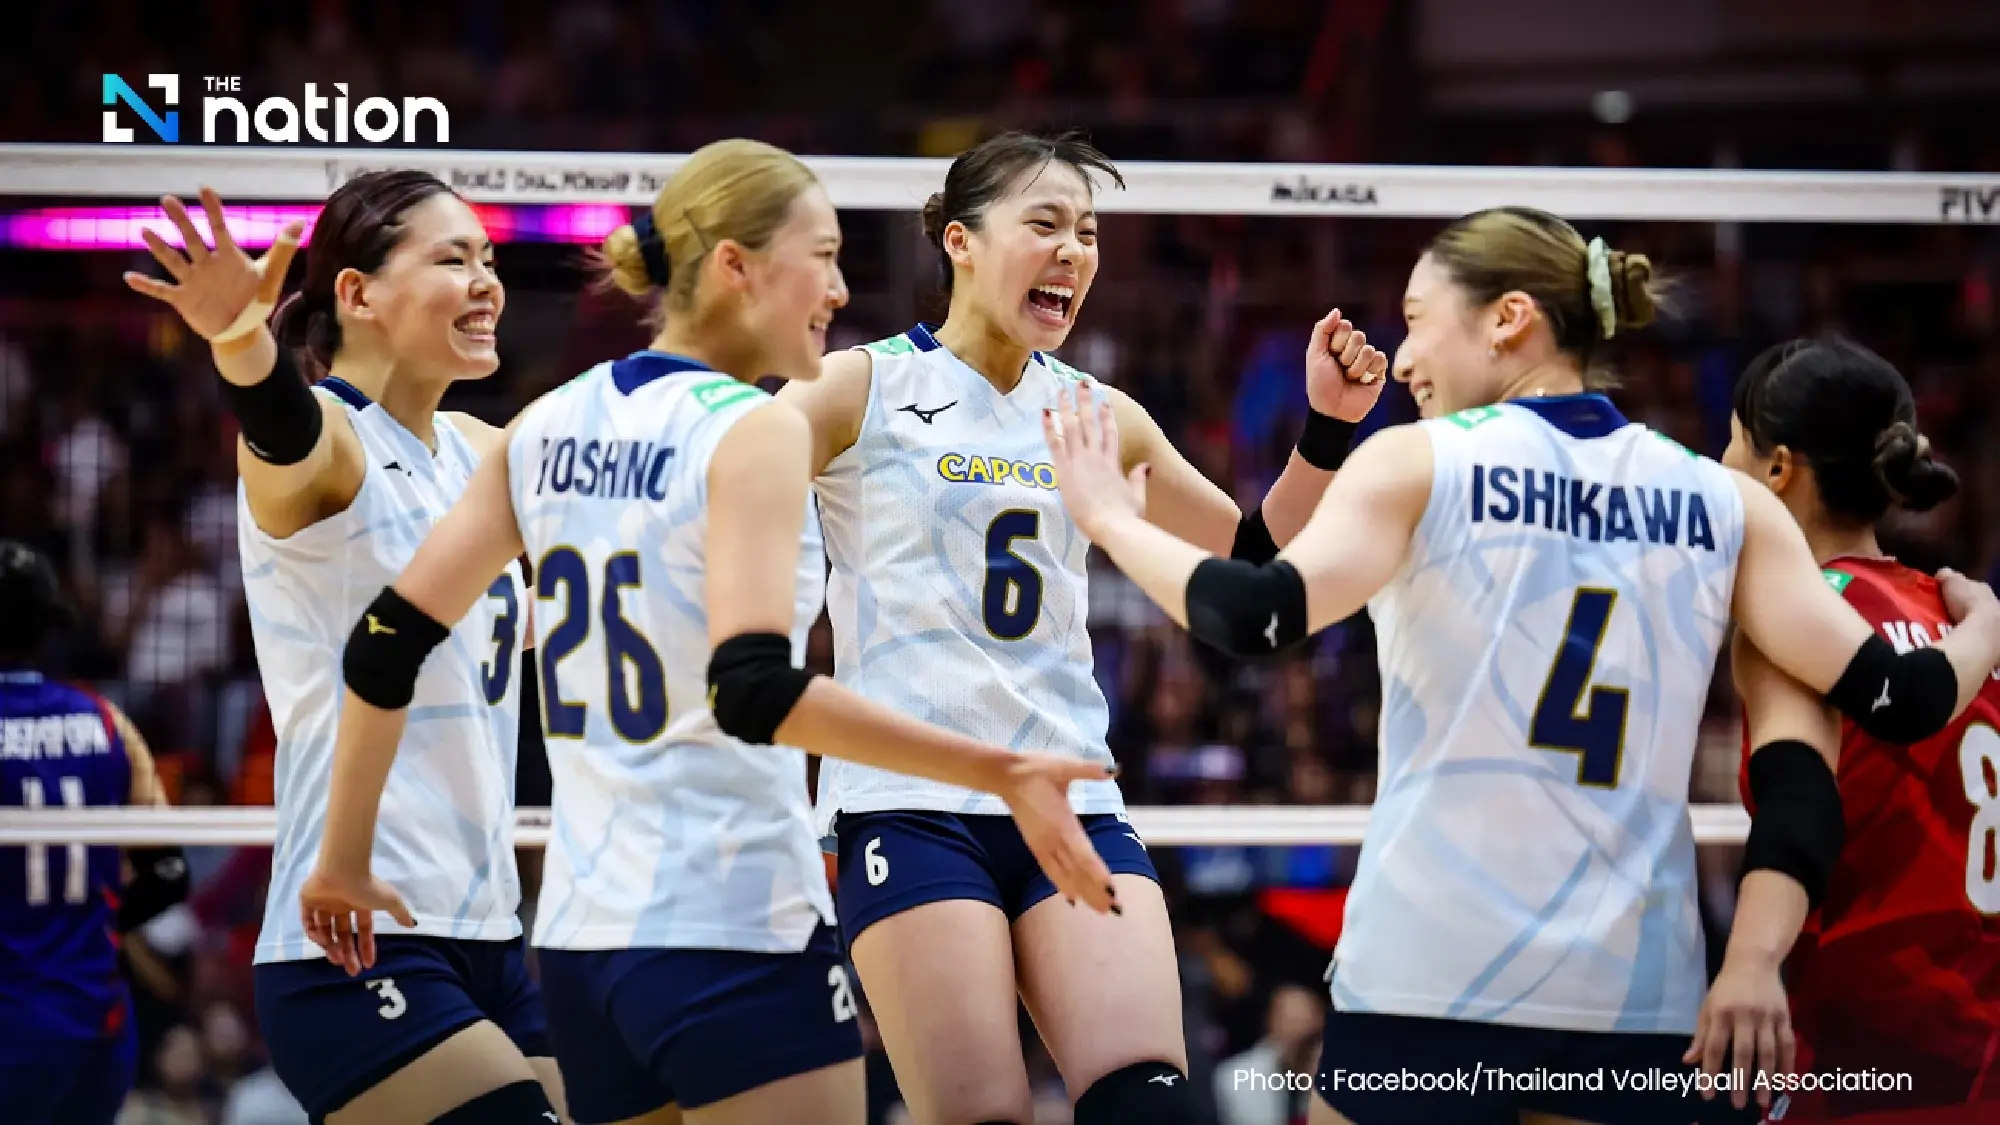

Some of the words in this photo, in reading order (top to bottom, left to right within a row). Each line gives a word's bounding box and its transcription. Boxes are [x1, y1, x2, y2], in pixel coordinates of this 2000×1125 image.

[1940, 186, 2000, 222] FIV
[936, 451, 1059, 492] CAPCO
[1471, 464, 1715, 551] ISHIKAWA
[981, 508, 1043, 641] 6
[480, 572, 519, 706] 3
[536, 545, 669, 743] 26
[1528, 587, 1630, 790] 4
[865, 836, 889, 886] 6
[1957, 720, 2000, 915] 8
[366, 978, 407, 1020] 3
[828, 965, 858, 1023] 2
